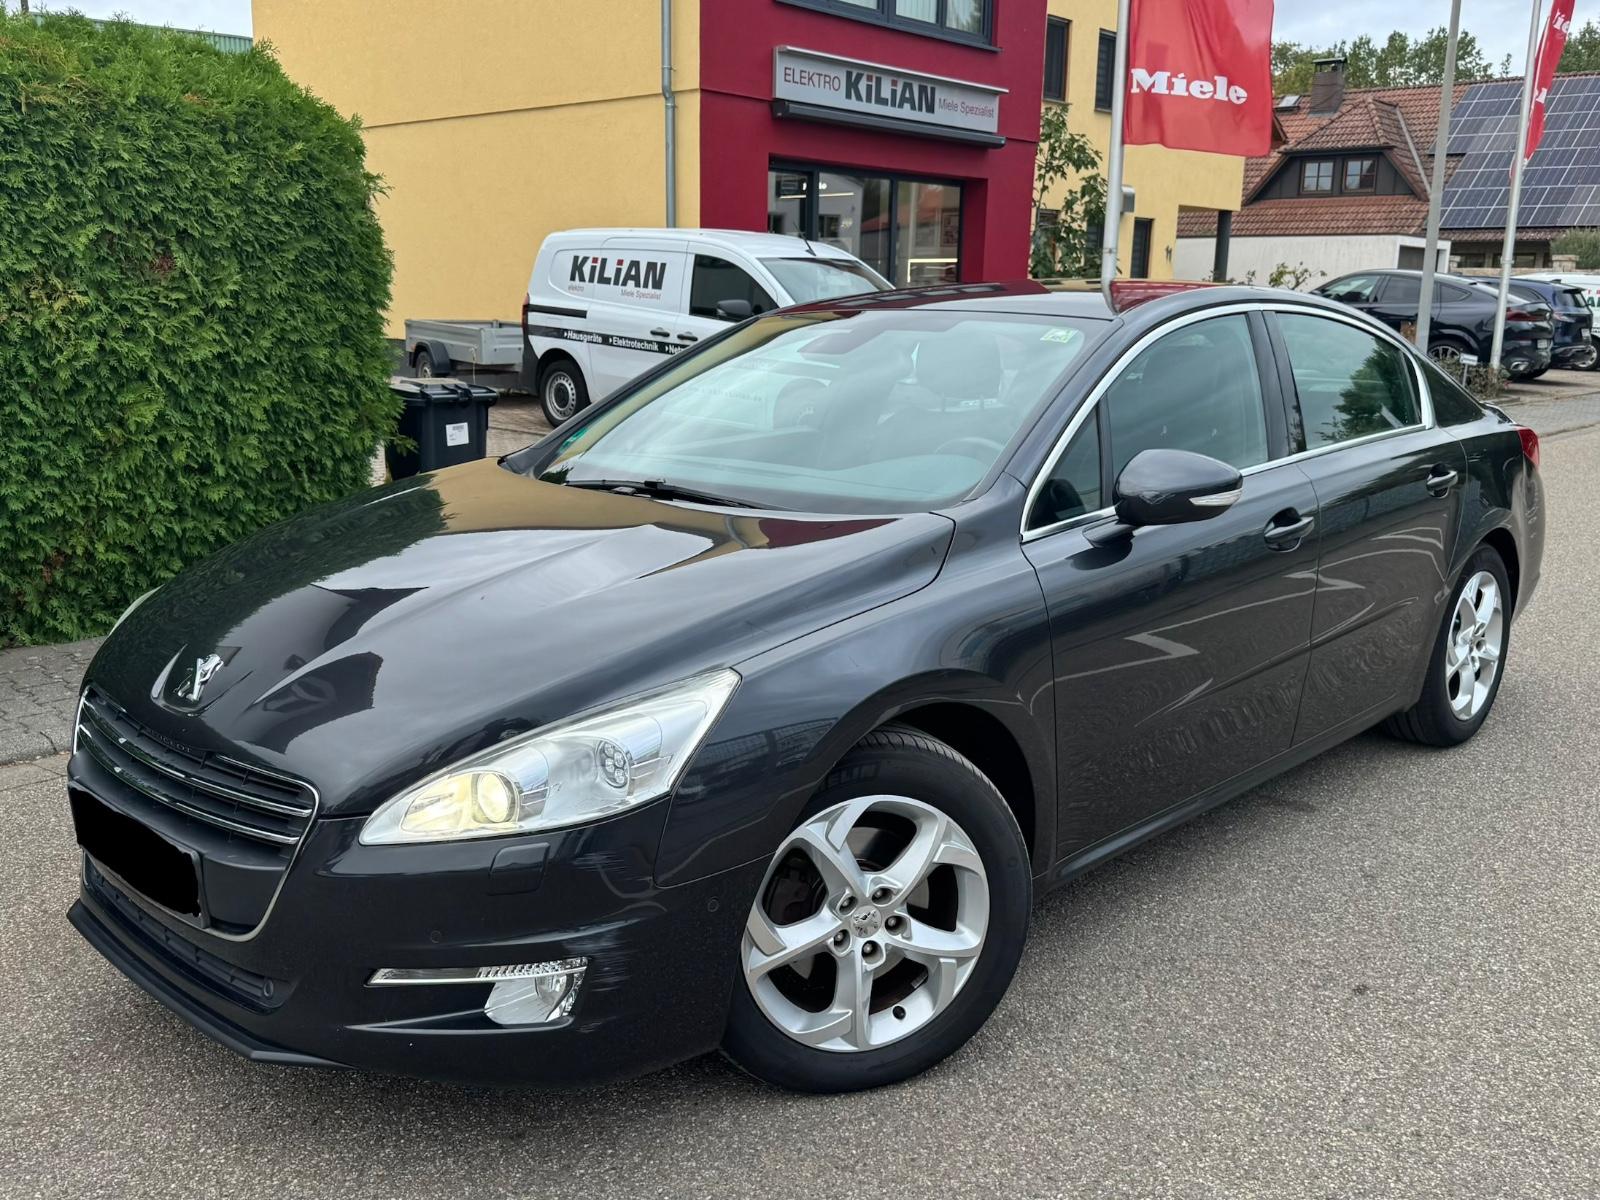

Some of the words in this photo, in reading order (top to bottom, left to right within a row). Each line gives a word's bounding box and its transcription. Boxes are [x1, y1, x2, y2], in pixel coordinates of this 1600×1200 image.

[784, 66, 841, 91] ELEKTRO
[939, 97, 959, 112] Miele
[960, 101, 994, 120] Spezialist
[1130, 68, 1248, 105] Miele
[567, 330, 603, 343] Hausgeräte
[612, 336, 659, 351] Elektrotechnik
